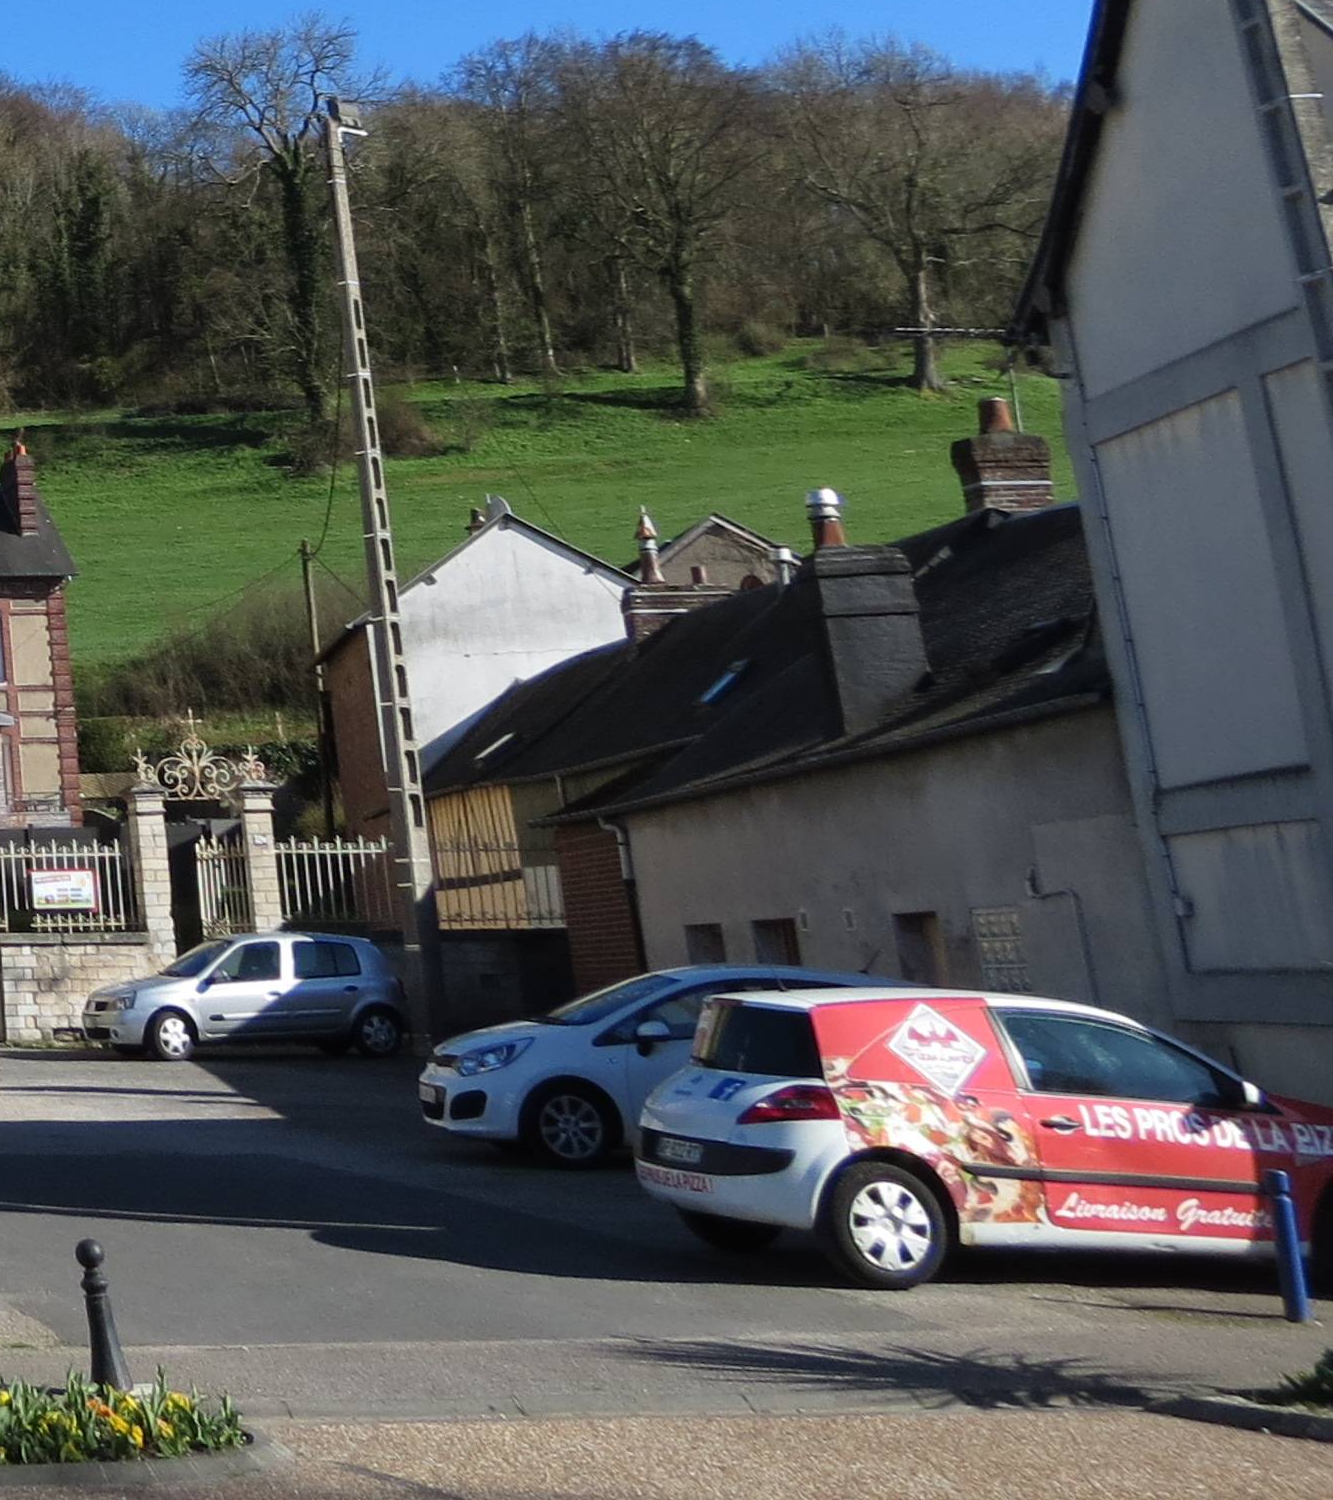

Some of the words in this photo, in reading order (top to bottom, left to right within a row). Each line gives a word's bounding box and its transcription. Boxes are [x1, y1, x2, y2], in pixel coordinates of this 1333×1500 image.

[1079, 1104, 1132, 1139] LES
[1134, 1107, 1211, 1148] PROS
[1209, 1115, 1252, 1150] DE
[1250, 1119, 1292, 1153] LA
[1055, 1192, 1168, 1222] Livraison
